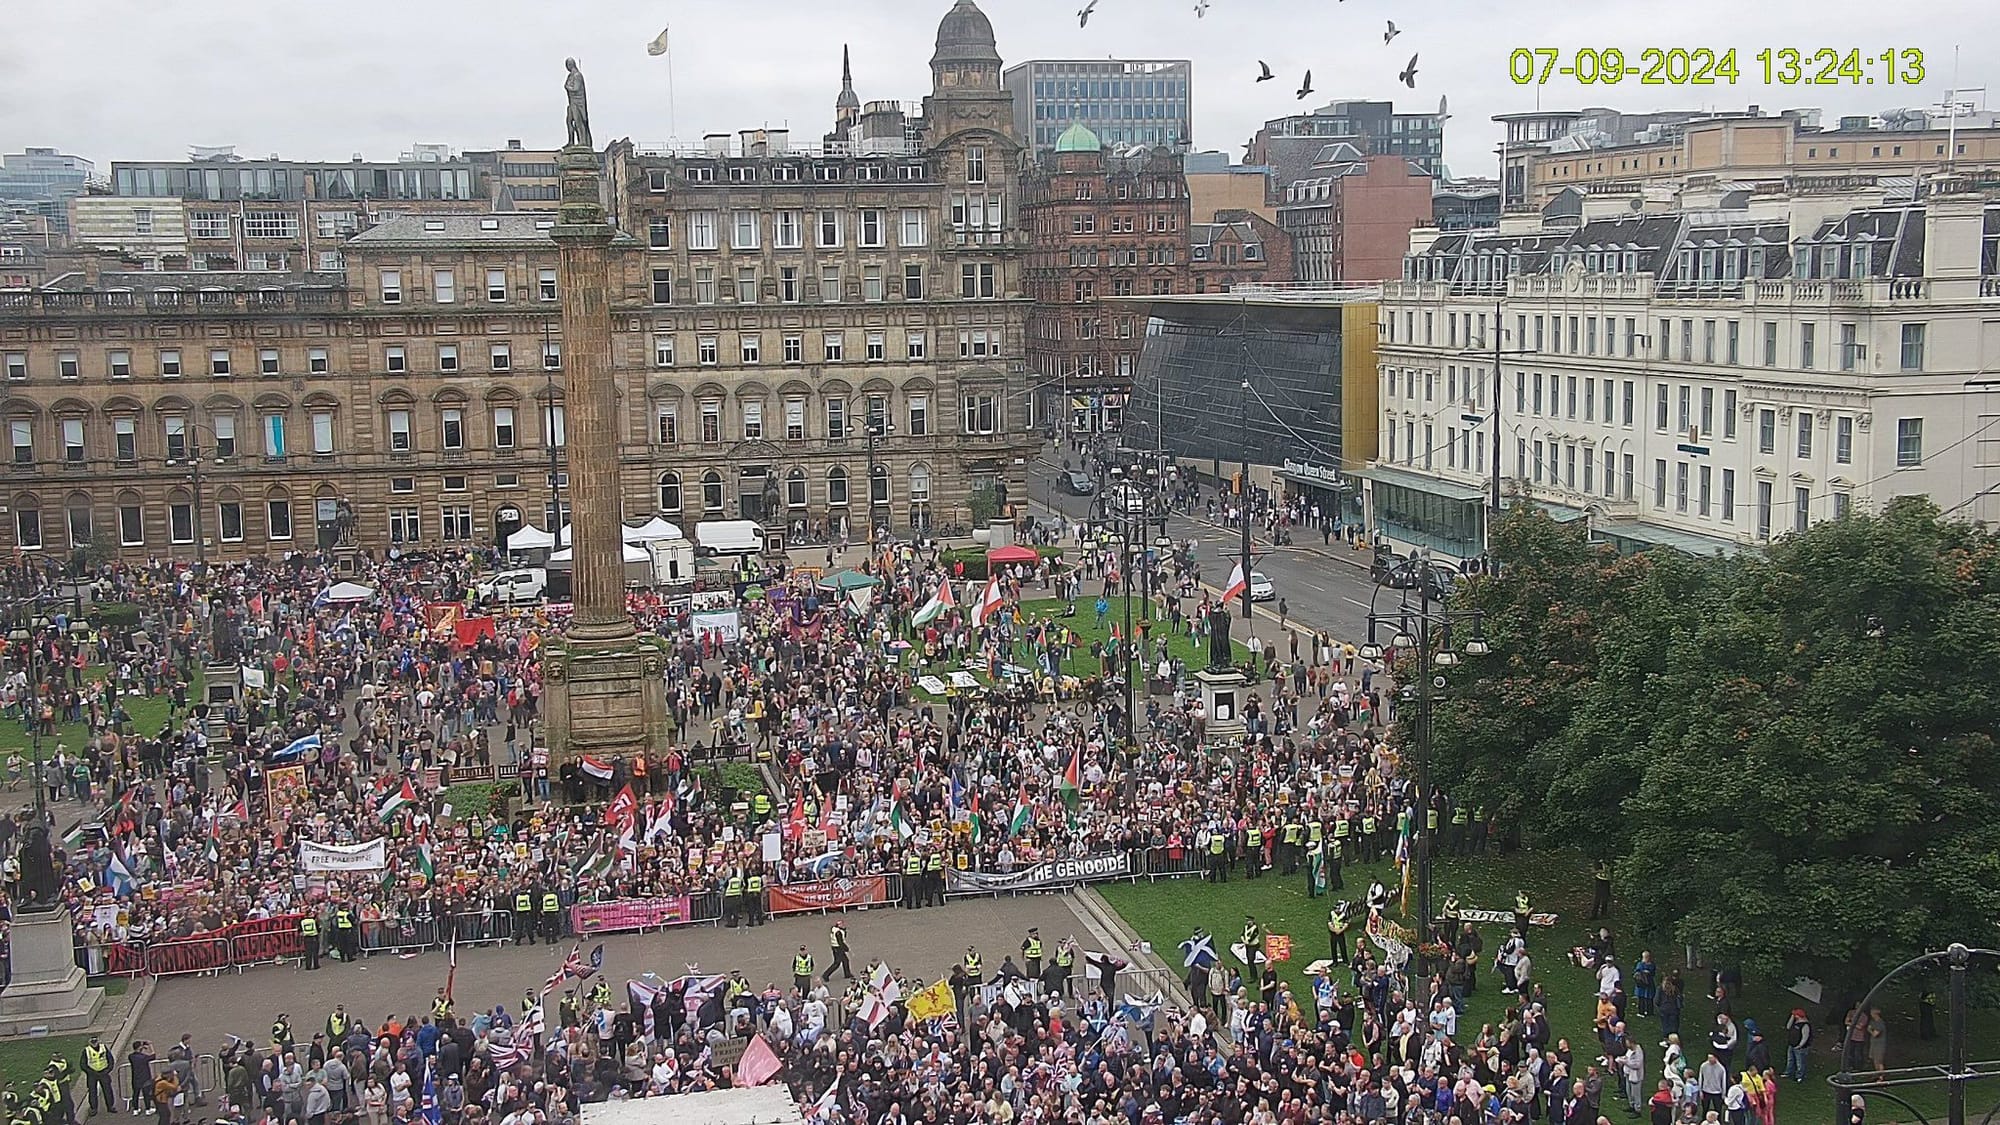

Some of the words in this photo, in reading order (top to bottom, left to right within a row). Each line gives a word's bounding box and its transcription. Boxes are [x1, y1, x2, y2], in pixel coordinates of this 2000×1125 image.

[1304, 462, 1319, 478] Queen
[1320, 465, 1337, 481] Street
[312, 855, 329, 863] FREE
[1028, 864, 1053, 882] THE
[1056, 852, 1126, 877] GENOCIDE
